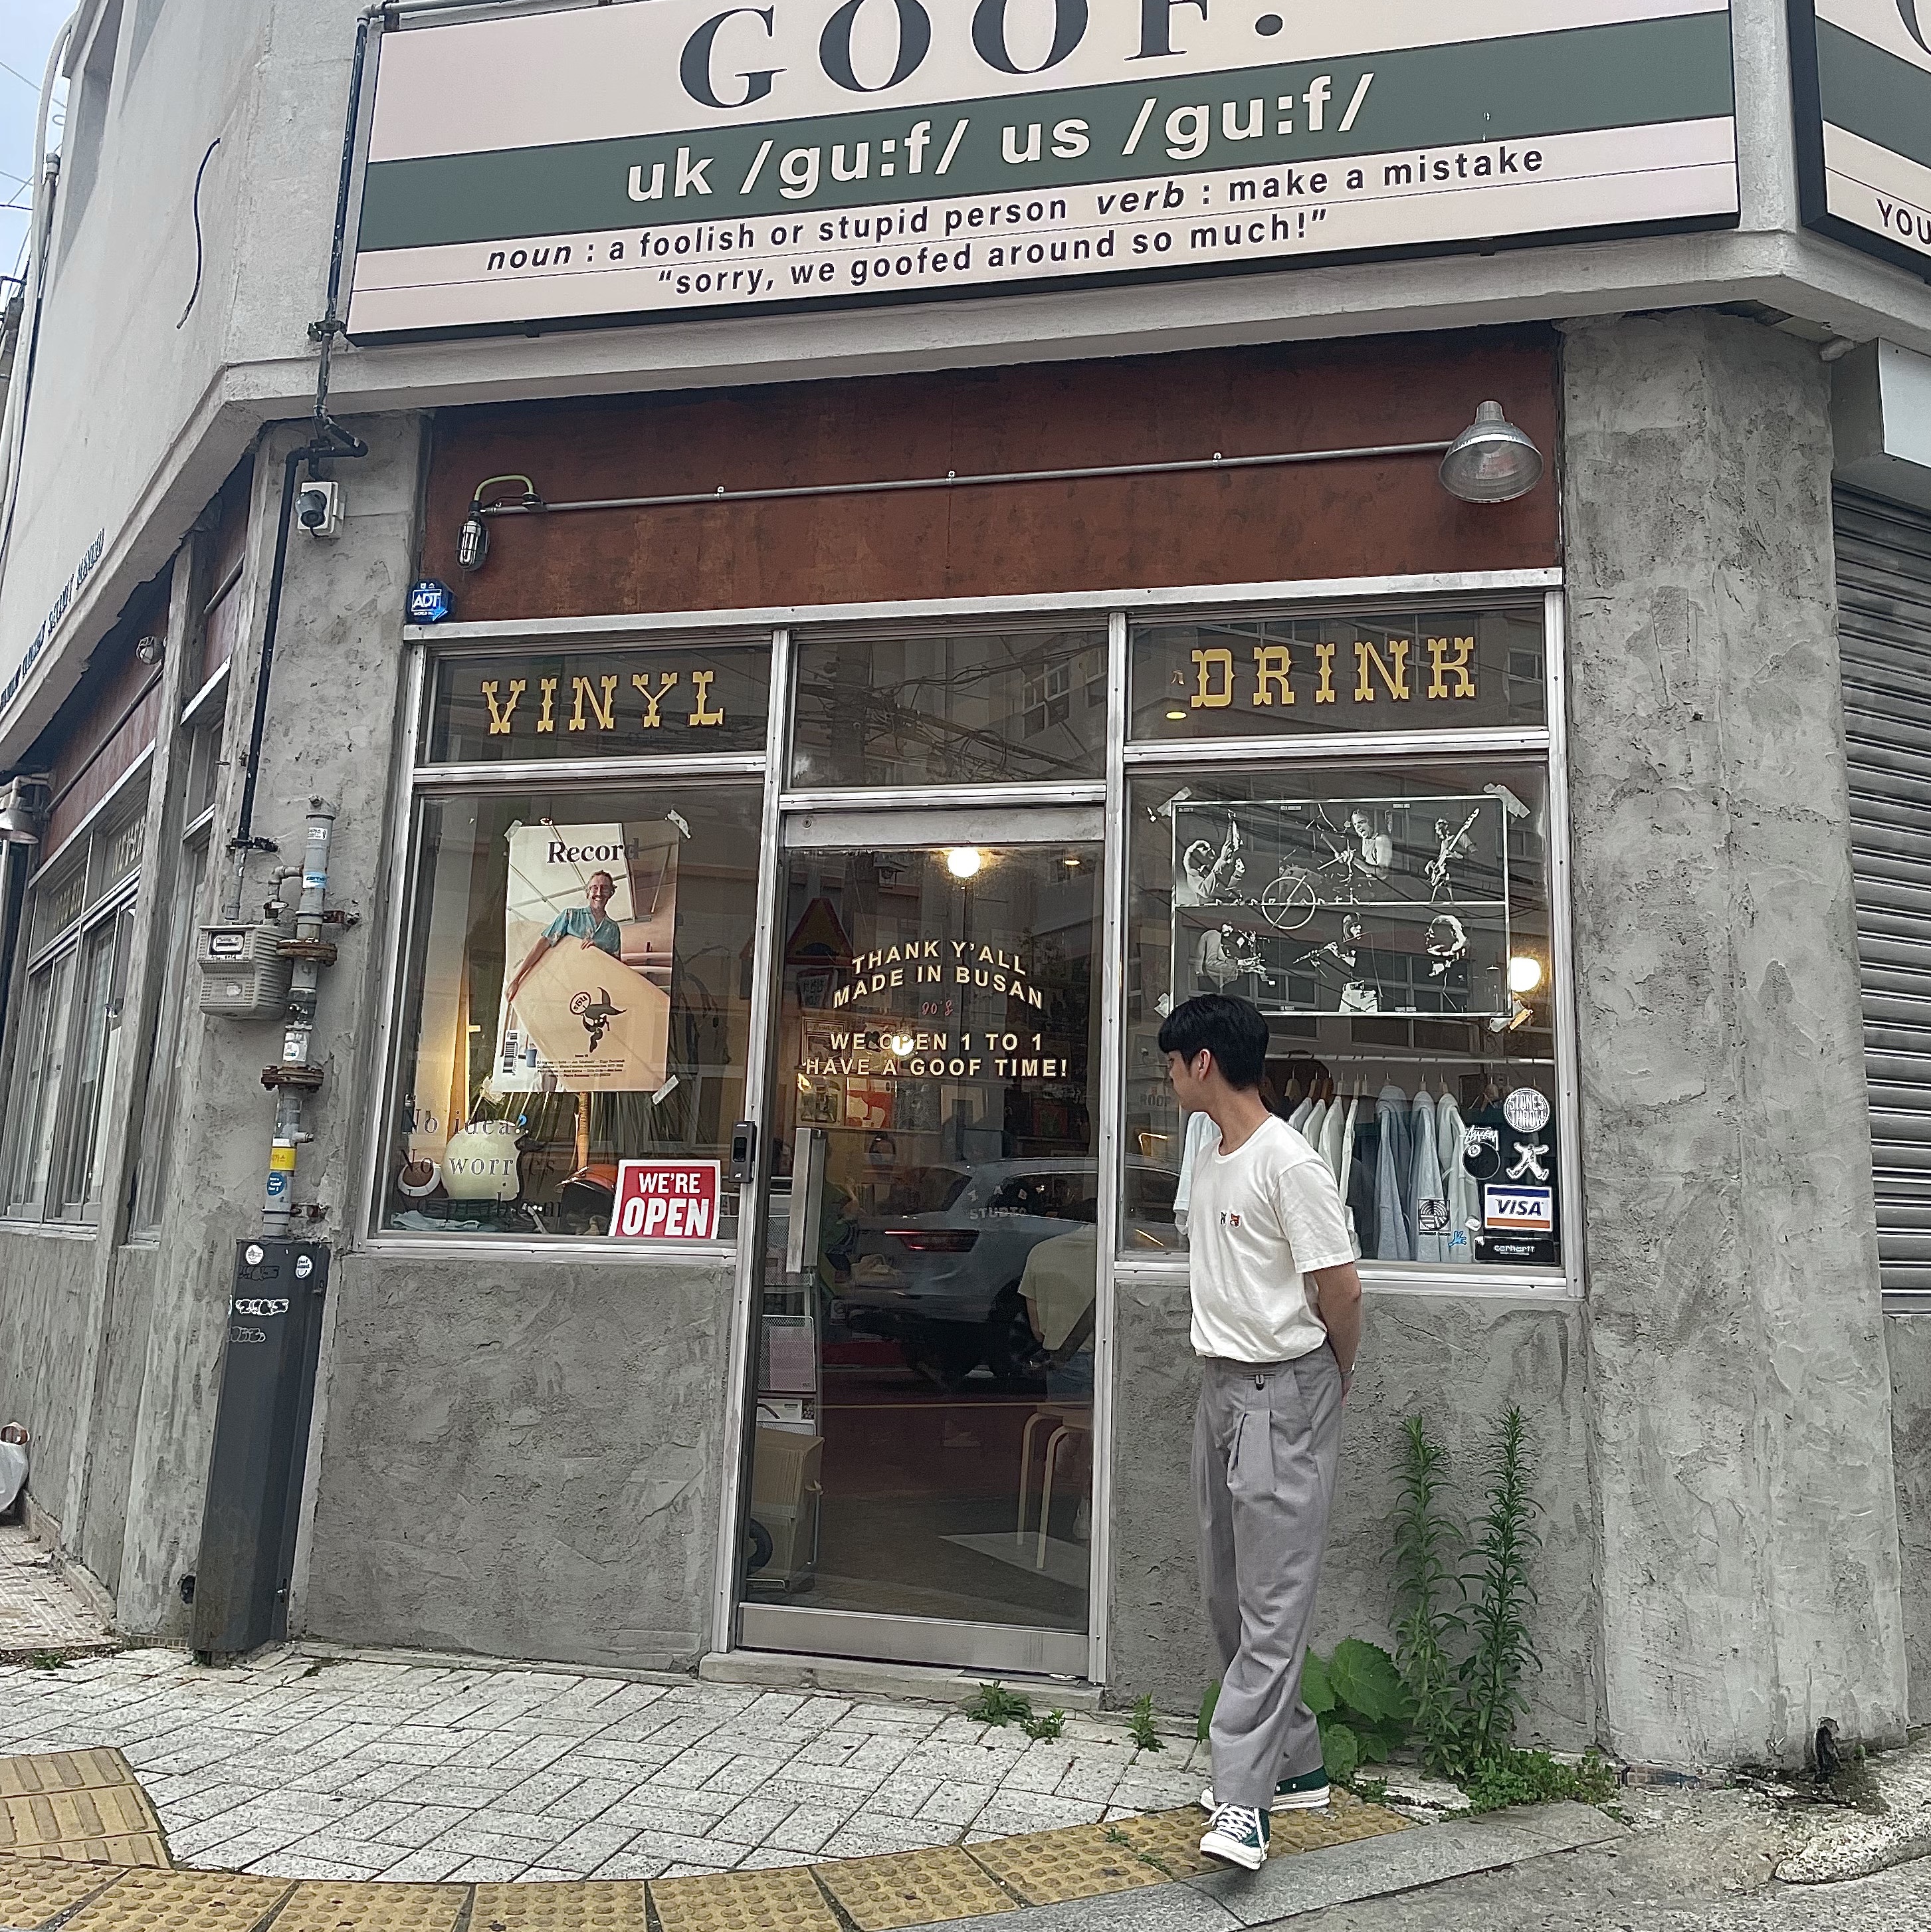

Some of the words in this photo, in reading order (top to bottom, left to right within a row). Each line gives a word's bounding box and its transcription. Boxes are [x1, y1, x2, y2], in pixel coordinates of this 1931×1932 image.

[627, 146, 714, 203] uk
[739, 118, 970, 201] /gu:f/
[1001, 115, 1091, 165] us
[1121, 72, 1375, 160] /gu:f/
[486, 244, 573, 272] noun
[586, 243, 593, 263] :
[608, 241, 625, 262] a
[639, 222, 756, 259] foolish
[770, 222, 805, 248] or
[819, 205, 929, 244] stupid
[944, 195, 1067, 236] person
[1095, 181, 1185, 218] verb
[1202, 186, 1210, 206] :
[1228, 169, 1328, 205] make
[1346, 169, 1364, 189] a
[1383, 144, 1544, 187] mistake
[791, 259, 835, 284] we
[851, 244, 971, 286] goofed
[987, 237, 1115, 272] around
[1131, 231, 1173, 255] so
[411, 592, 442, 608] ADT
[1190, 636, 1475, 708] DRINK
[481, 670, 724, 735] VINYL
[546, 837, 640, 864] Record
[851, 940, 940, 975] THANK
[833, 968, 904, 1010] MADE
[916, 965, 942, 984] IN
[956, 966, 1043, 1010] BUSAN
[830, 1033, 866, 1051] WE
[878, 1033, 947, 1051] OPEN
[961, 1033, 971, 1051] 1
[985, 1033, 1018, 1051] TO
[1032, 1033, 1042, 1051] 1
[805, 1058, 870, 1076] HAVE
[882, 1058, 897, 1075] A
[910, 1058, 982, 1077] GOOF
[995, 1059, 1068, 1077] TIME!
[1508, 1093, 1544, 1111] STONES
[1510, 1111, 1544, 1128] THROW
[400, 1148, 434, 1174] No
[621, 1196, 710, 1236] OPEN
[1495, 1198, 1543, 1216] VISA
[1494, 1244, 1536, 1253] carhartt
